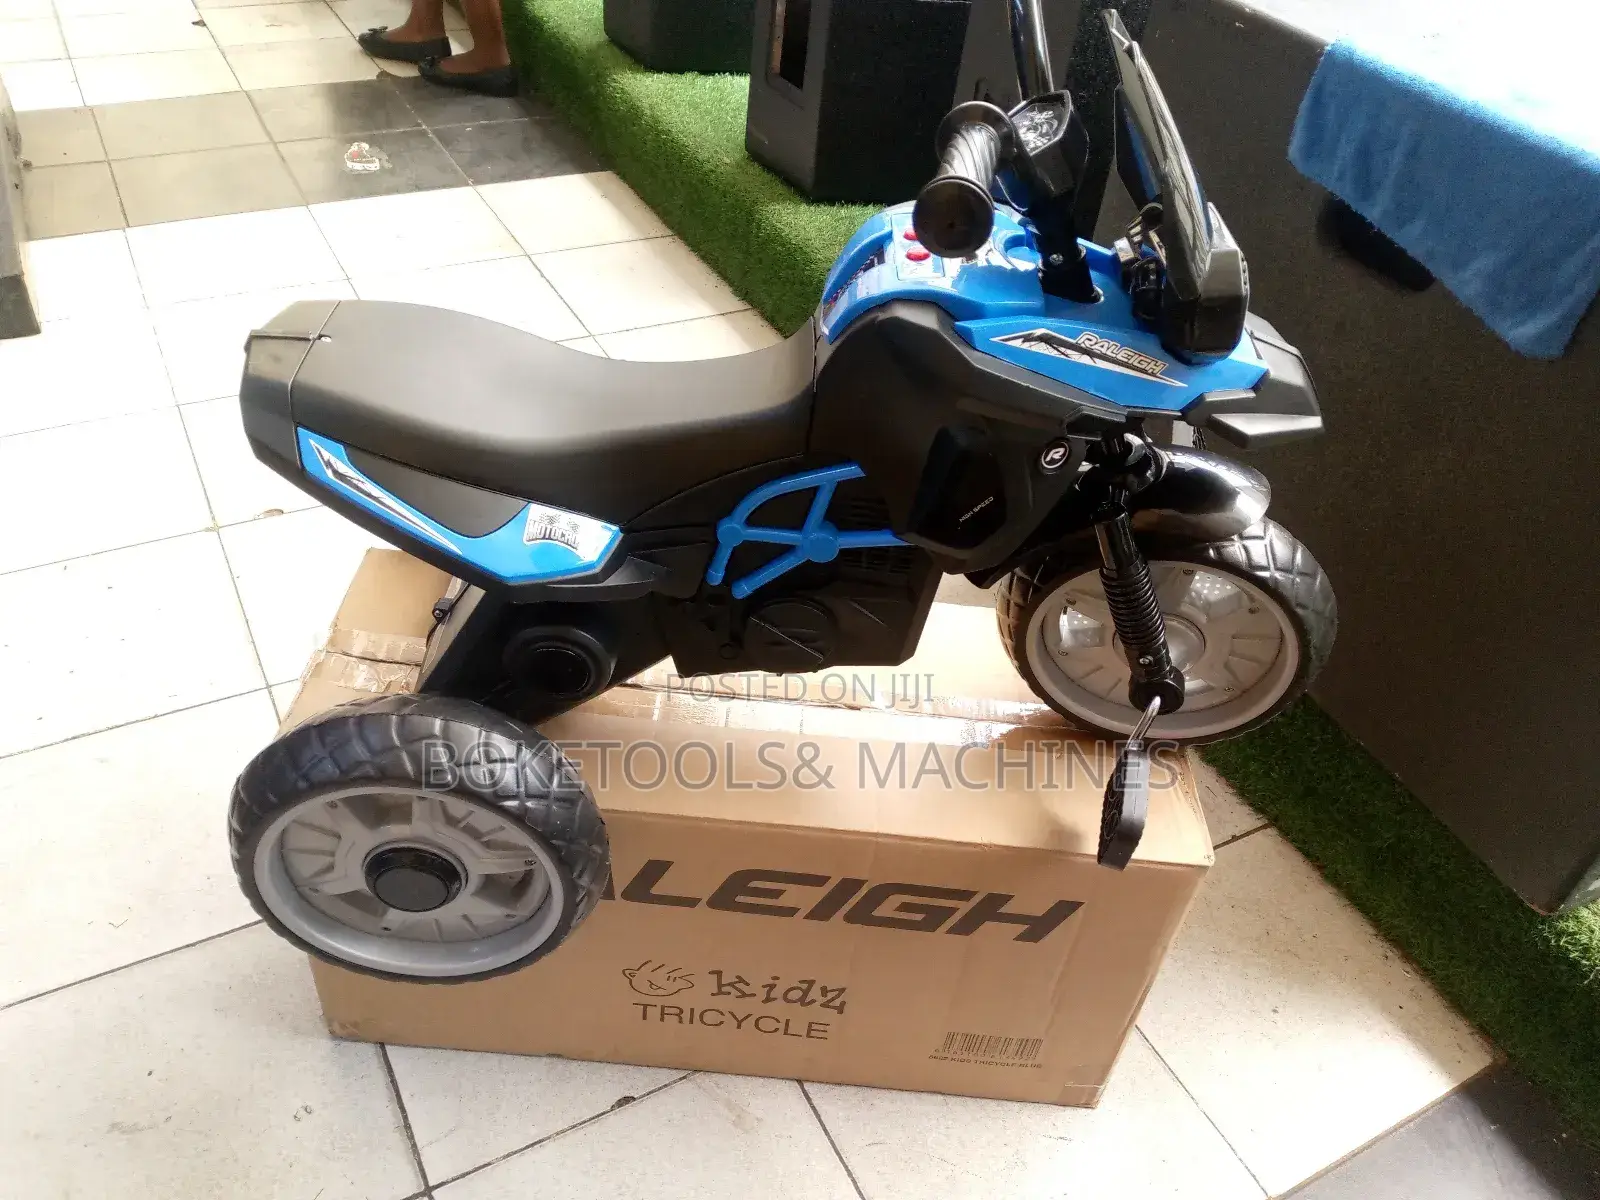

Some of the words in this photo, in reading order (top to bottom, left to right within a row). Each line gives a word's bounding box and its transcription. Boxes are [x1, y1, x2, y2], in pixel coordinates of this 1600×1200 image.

[1077, 333, 1168, 374] RALEIGH
[1045, 447, 1065, 462] R
[601, 858, 1086, 944] LEIGH
[632, 1002, 831, 1040] TRICYCLE
